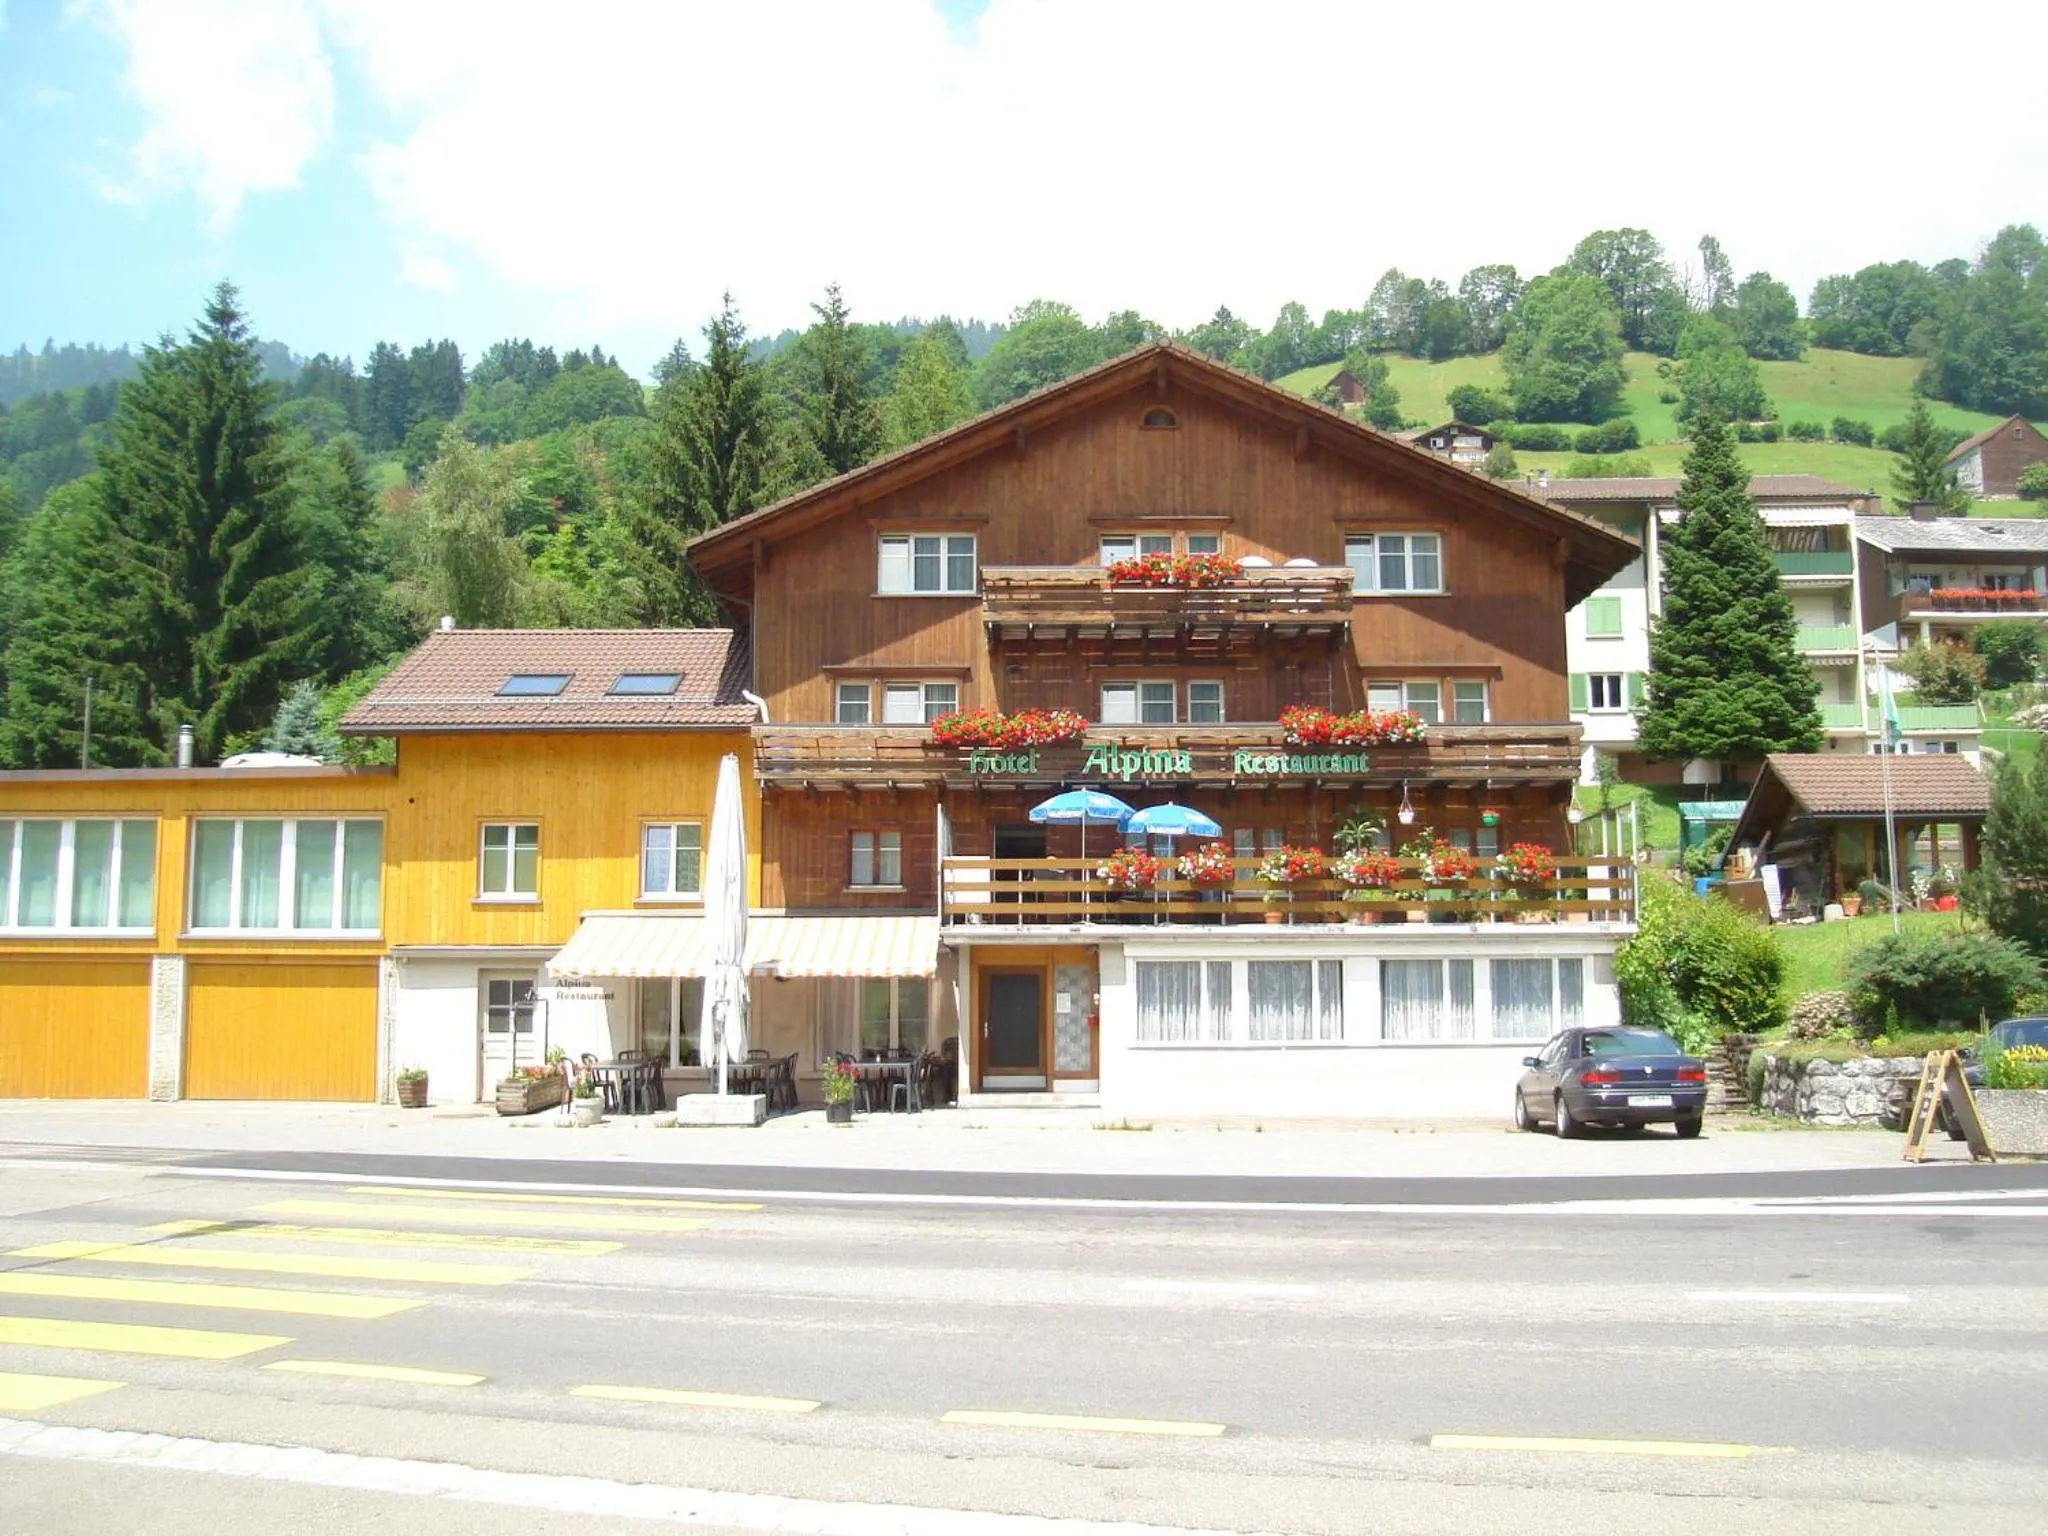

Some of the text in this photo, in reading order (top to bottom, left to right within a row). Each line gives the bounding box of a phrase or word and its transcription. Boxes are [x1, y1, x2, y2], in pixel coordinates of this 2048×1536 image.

[969, 743, 1370, 782] Hotel Alpina Restaurant
